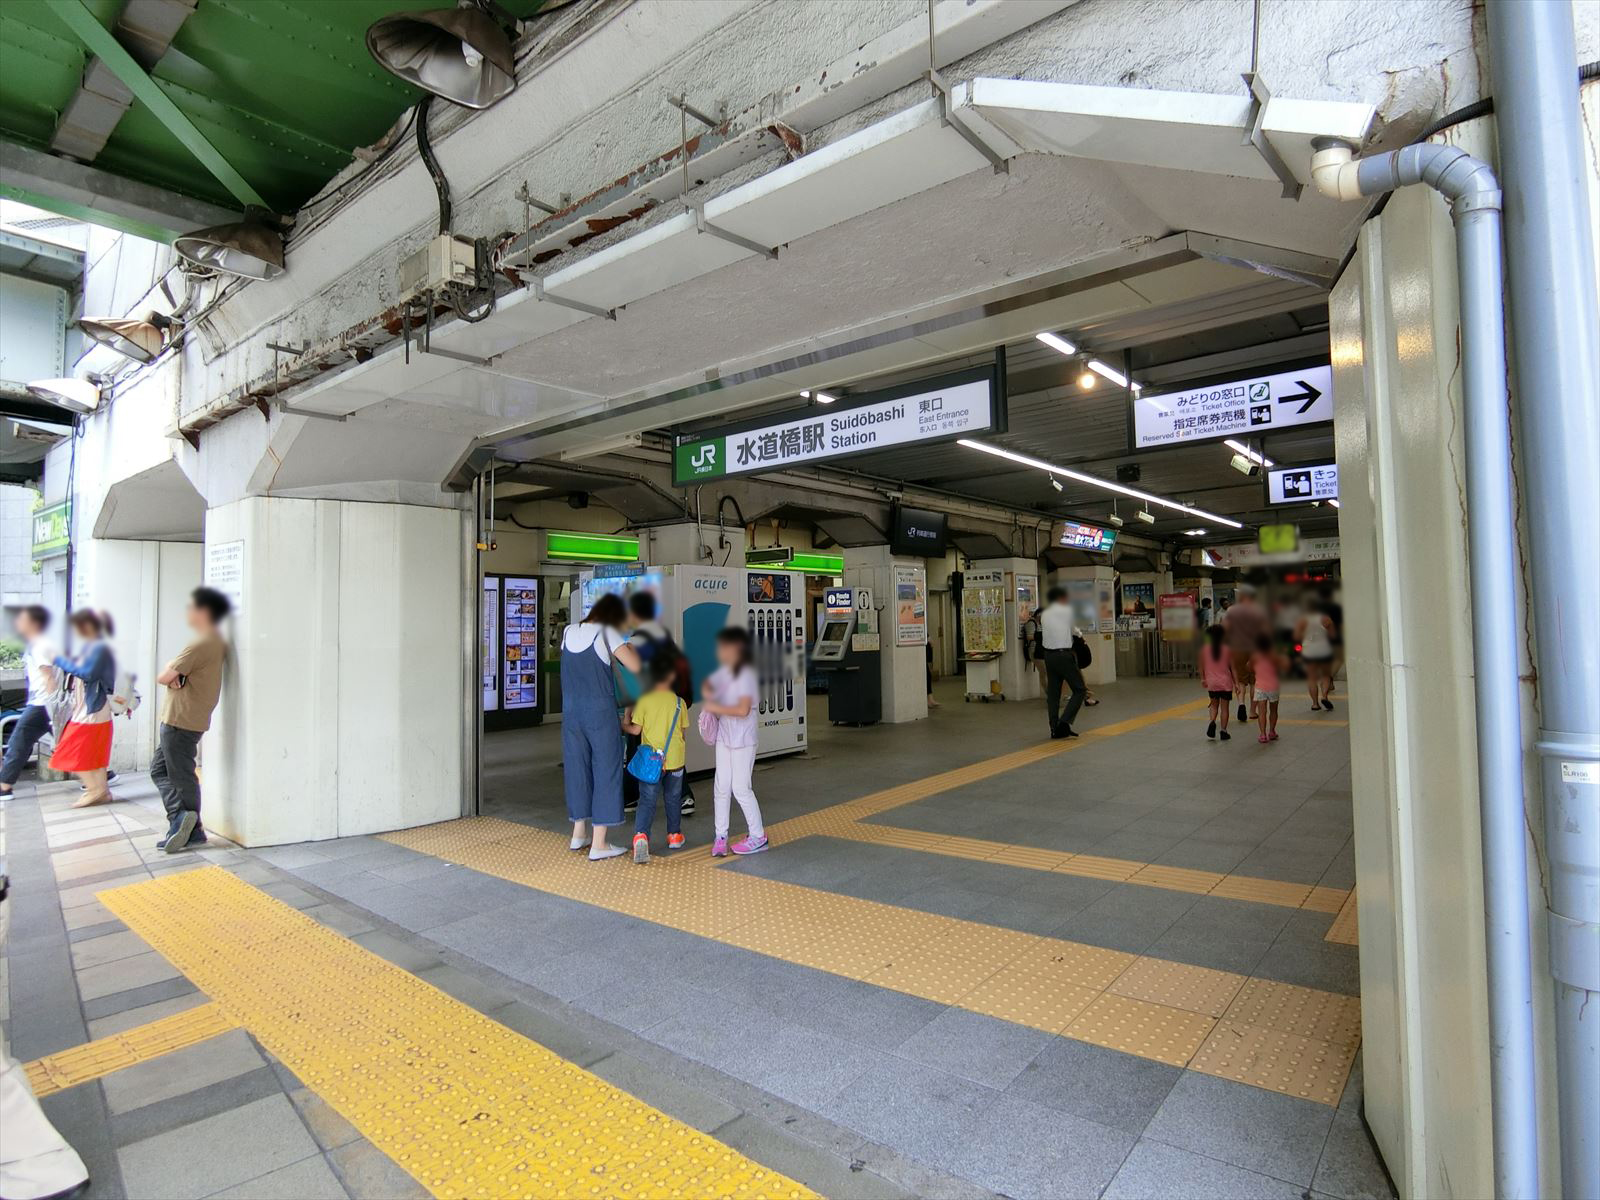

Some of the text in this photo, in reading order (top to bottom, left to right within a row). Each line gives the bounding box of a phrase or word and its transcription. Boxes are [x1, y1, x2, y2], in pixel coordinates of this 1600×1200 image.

[918, 397, 943, 414] 東口
[1177, 386, 1245, 407] みどりの窓口
[1201, 401, 1223, 411] Ticket
[1224, 399, 1246, 408] Office
[830, 404, 905, 432] Suidōbashi
[918, 408, 969, 425] East Entrance
[1173, 408, 1246, 430] 指定席券売機
[831, 430, 876, 449] Station
[1142, 431, 1175, 443] Reserved
[1194, 424, 1215, 436] Ticket
[1216, 421, 1247, 432] Machine
[736, 422, 825, 466] 水道橋駅
[691, 444, 716, 467] JR
[1314, 480, 1337, 489] Ticket
[694, 579, 728, 590] acure
[764, 719, 780, 727] KIOSK
